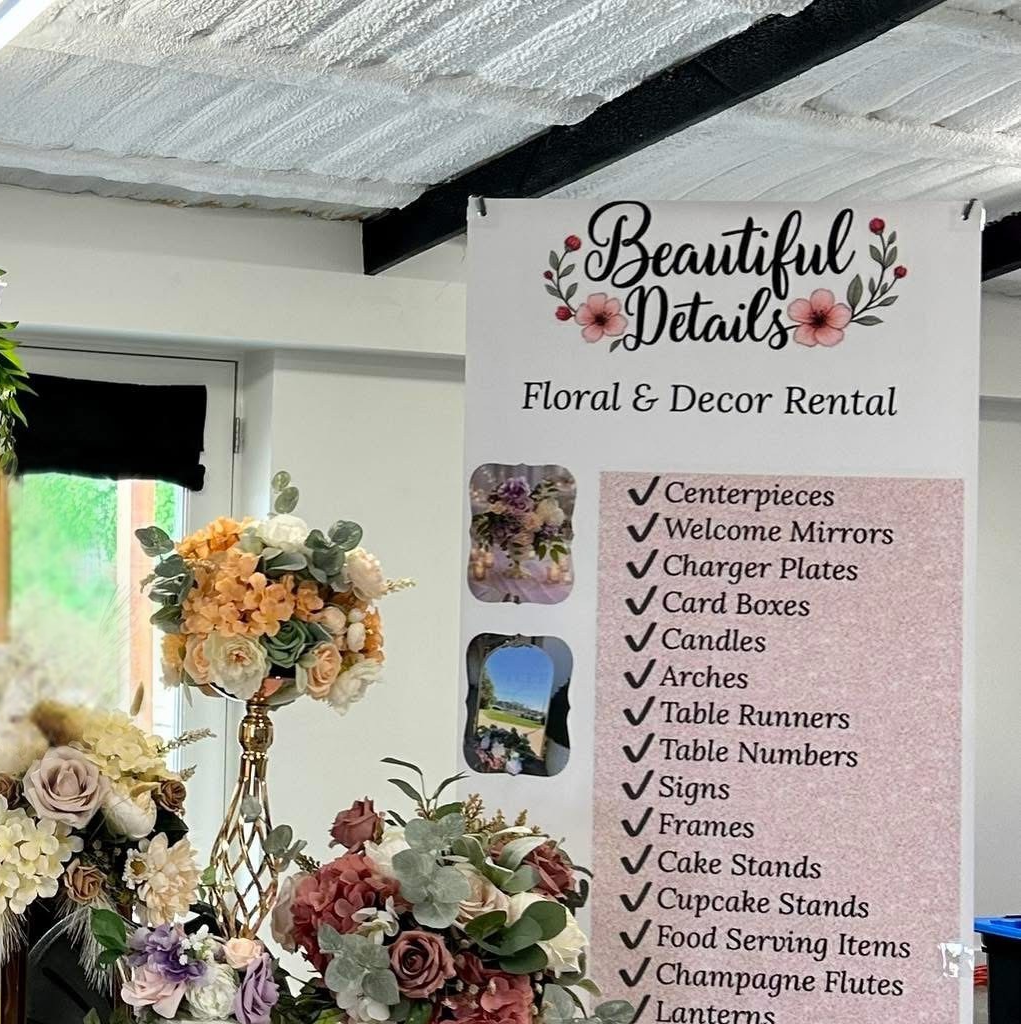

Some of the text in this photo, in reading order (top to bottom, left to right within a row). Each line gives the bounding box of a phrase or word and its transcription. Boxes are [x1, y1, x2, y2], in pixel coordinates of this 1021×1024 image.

[584, 200, 854, 299] Beautiful
[622, 285, 799, 351] Details
[523, 381, 897, 416] Floral & Decor Rental
[665, 482, 834, 512] Centerpieces
[664, 518, 893, 544] Welcome Mirrors
[664, 554, 858, 584] Charger Plates
[663, 591, 810, 616] Card Boxes
[662, 628, 765, 652] Candles
[659, 665, 748, 689] Arches
[660, 702, 849, 729] Table Runners
[660, 739, 857, 767] Table Numbers
[659, 776, 729, 805] Signs
[659, 813, 754, 838] Frames
[658, 851, 821, 879] Cake Stands
[658, 887, 868, 918] Cupcake Stands
[657, 925, 910, 961] Food Serving Items
[656, 962, 903, 997] Champagne Flutes
